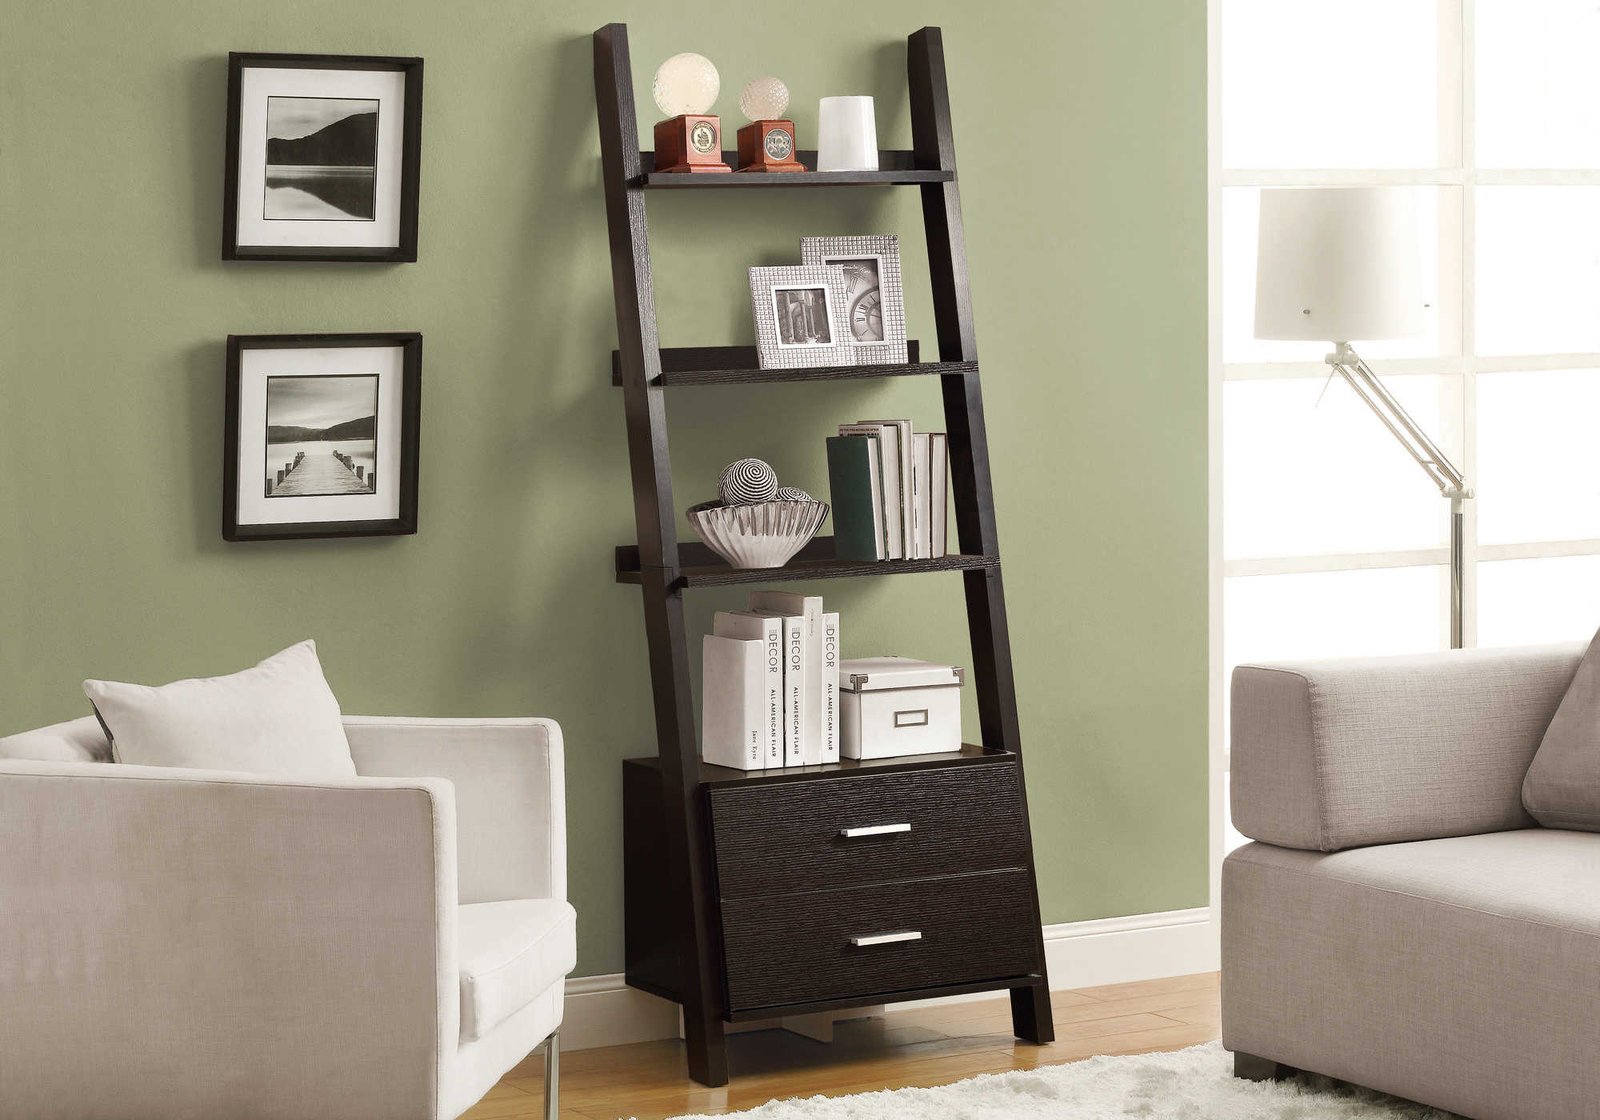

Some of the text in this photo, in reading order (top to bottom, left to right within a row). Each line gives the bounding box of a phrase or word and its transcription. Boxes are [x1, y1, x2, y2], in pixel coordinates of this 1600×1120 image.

[768, 633, 778, 673] DECOR
[791, 631, 801, 671] DECOR
[826, 628, 835, 668] DECOR
